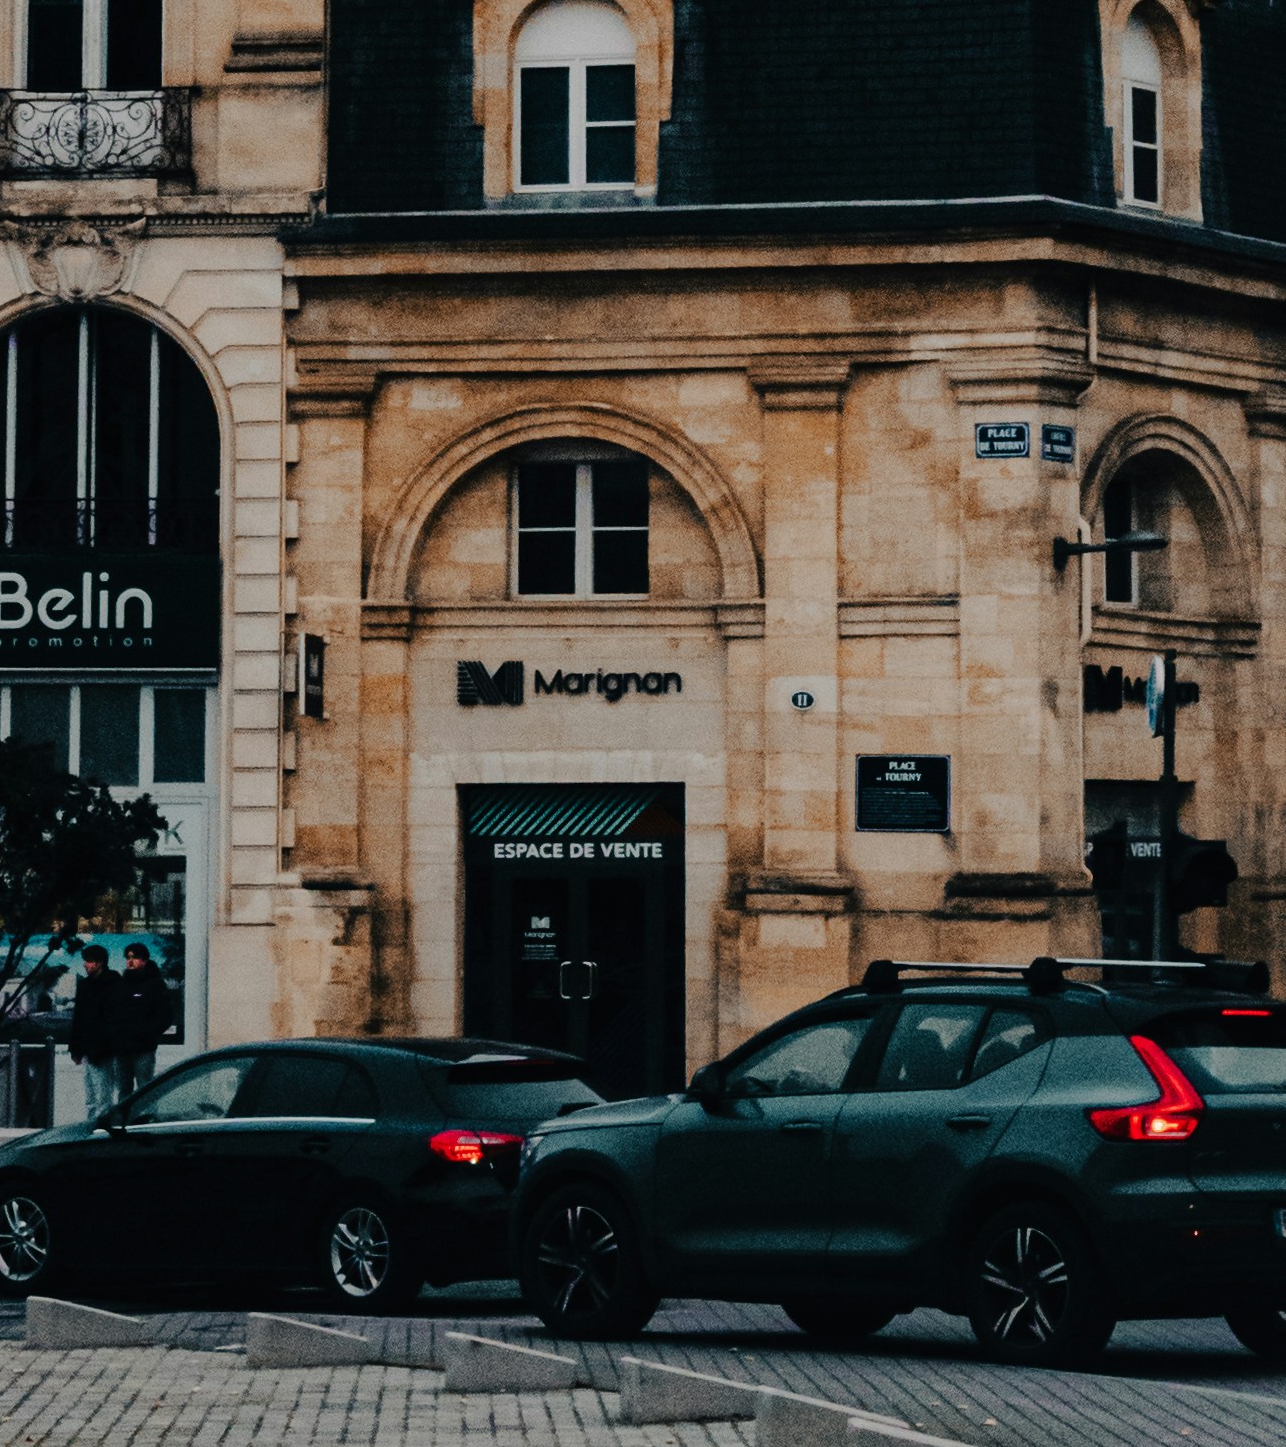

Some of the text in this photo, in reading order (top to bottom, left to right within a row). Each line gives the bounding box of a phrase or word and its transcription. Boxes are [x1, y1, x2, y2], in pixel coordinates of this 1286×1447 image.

[987, 428, 1018, 439] PLACE
[979, 441, 1025, 452] DE TOURNY
[535, 668, 682, 702] Marignan
[797, 693, 808, 706] 11
[889, 761, 916, 770] PLACE
[885, 772, 922, 782] TOURNY
[493, 842, 663, 859] ESPACE DE VENTE
